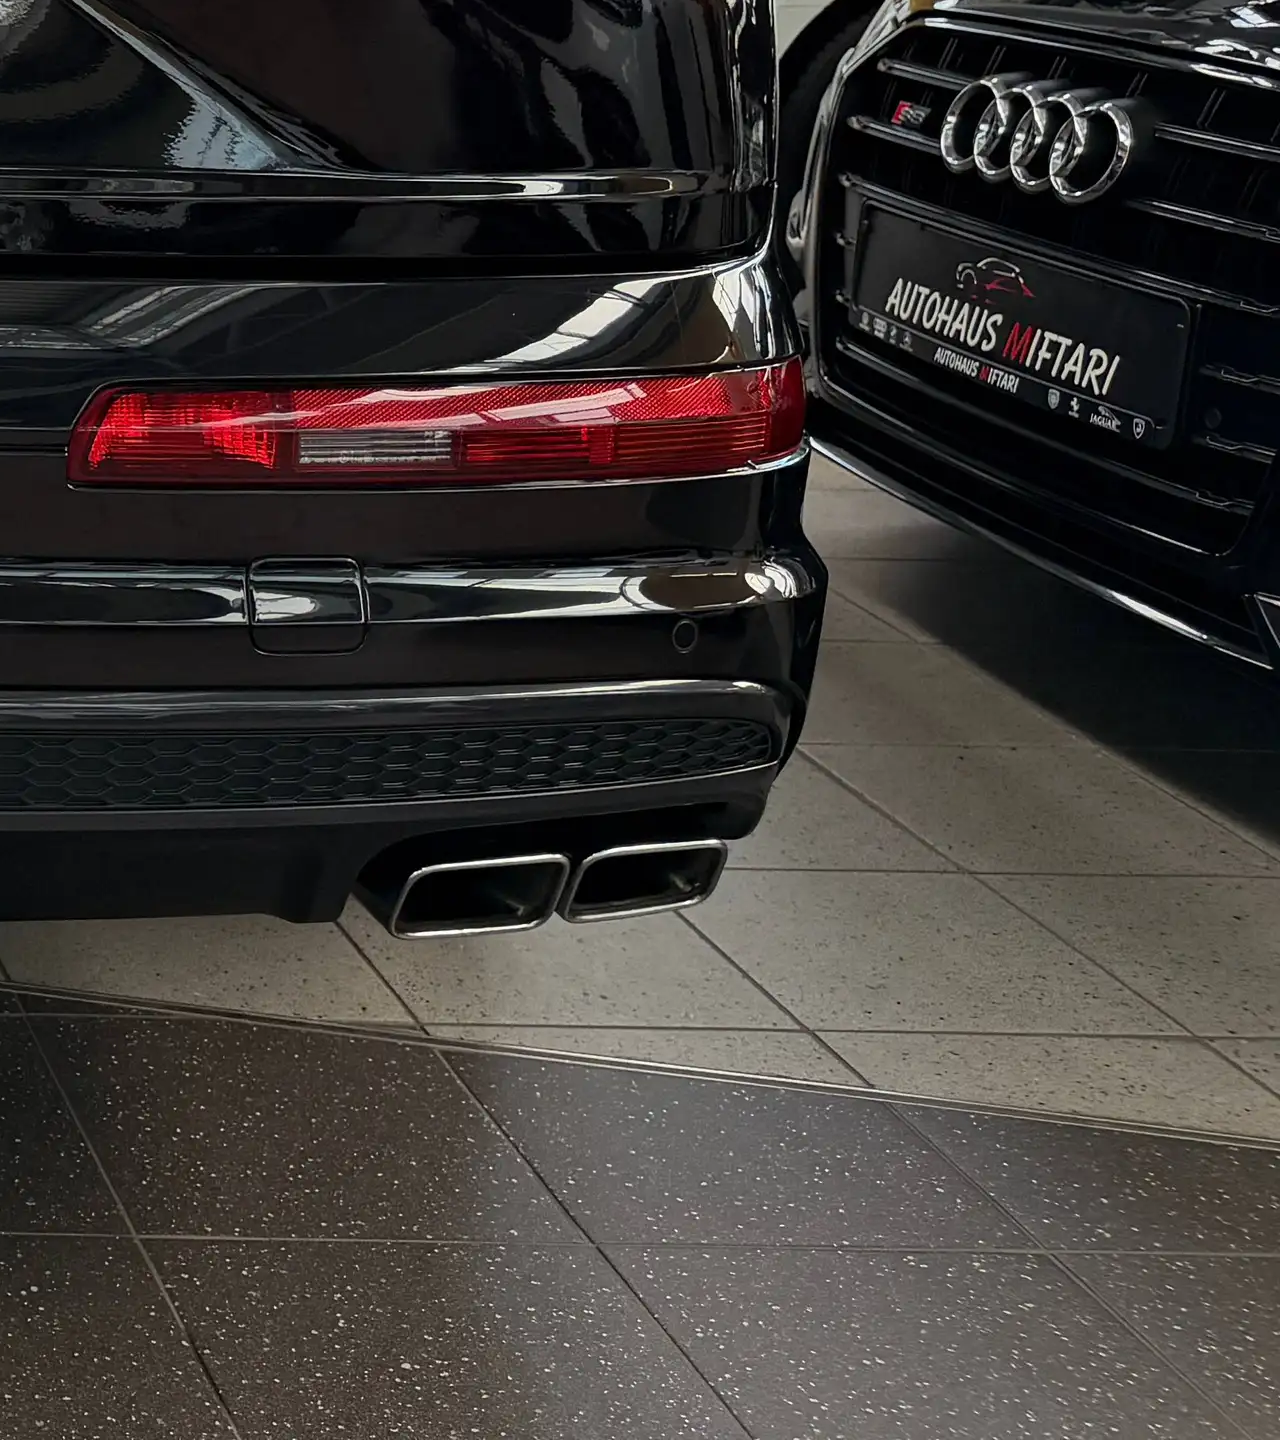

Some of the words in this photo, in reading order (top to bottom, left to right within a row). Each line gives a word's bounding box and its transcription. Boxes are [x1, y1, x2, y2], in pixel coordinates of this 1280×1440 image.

[885, 277, 1003, 352] AUTOHAUS
[1002, 321, 1120, 397] MIFTARI
[933, 346, 980, 378] AUTOHAUS
[978, 364, 1020, 394] MIFTARI
